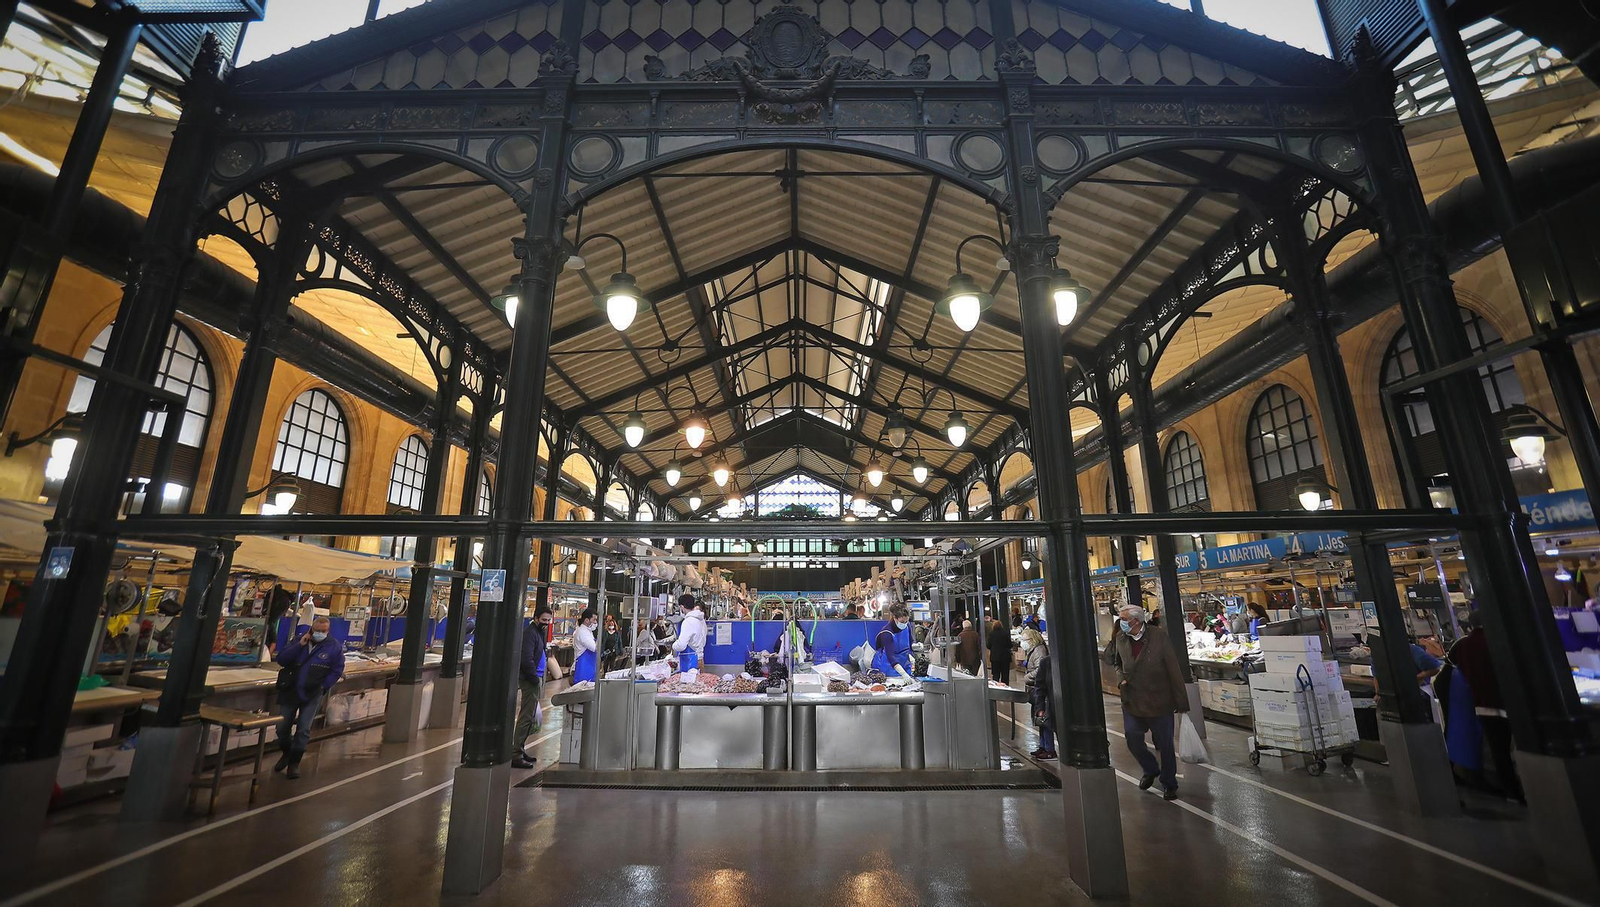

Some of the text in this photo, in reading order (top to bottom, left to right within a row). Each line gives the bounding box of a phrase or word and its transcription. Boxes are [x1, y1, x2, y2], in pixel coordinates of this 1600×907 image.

[1291, 535, 1302, 555] 4
[1175, 554, 1191, 569] SUR
[1199, 544, 1271, 570] 5 LA MARTINA
